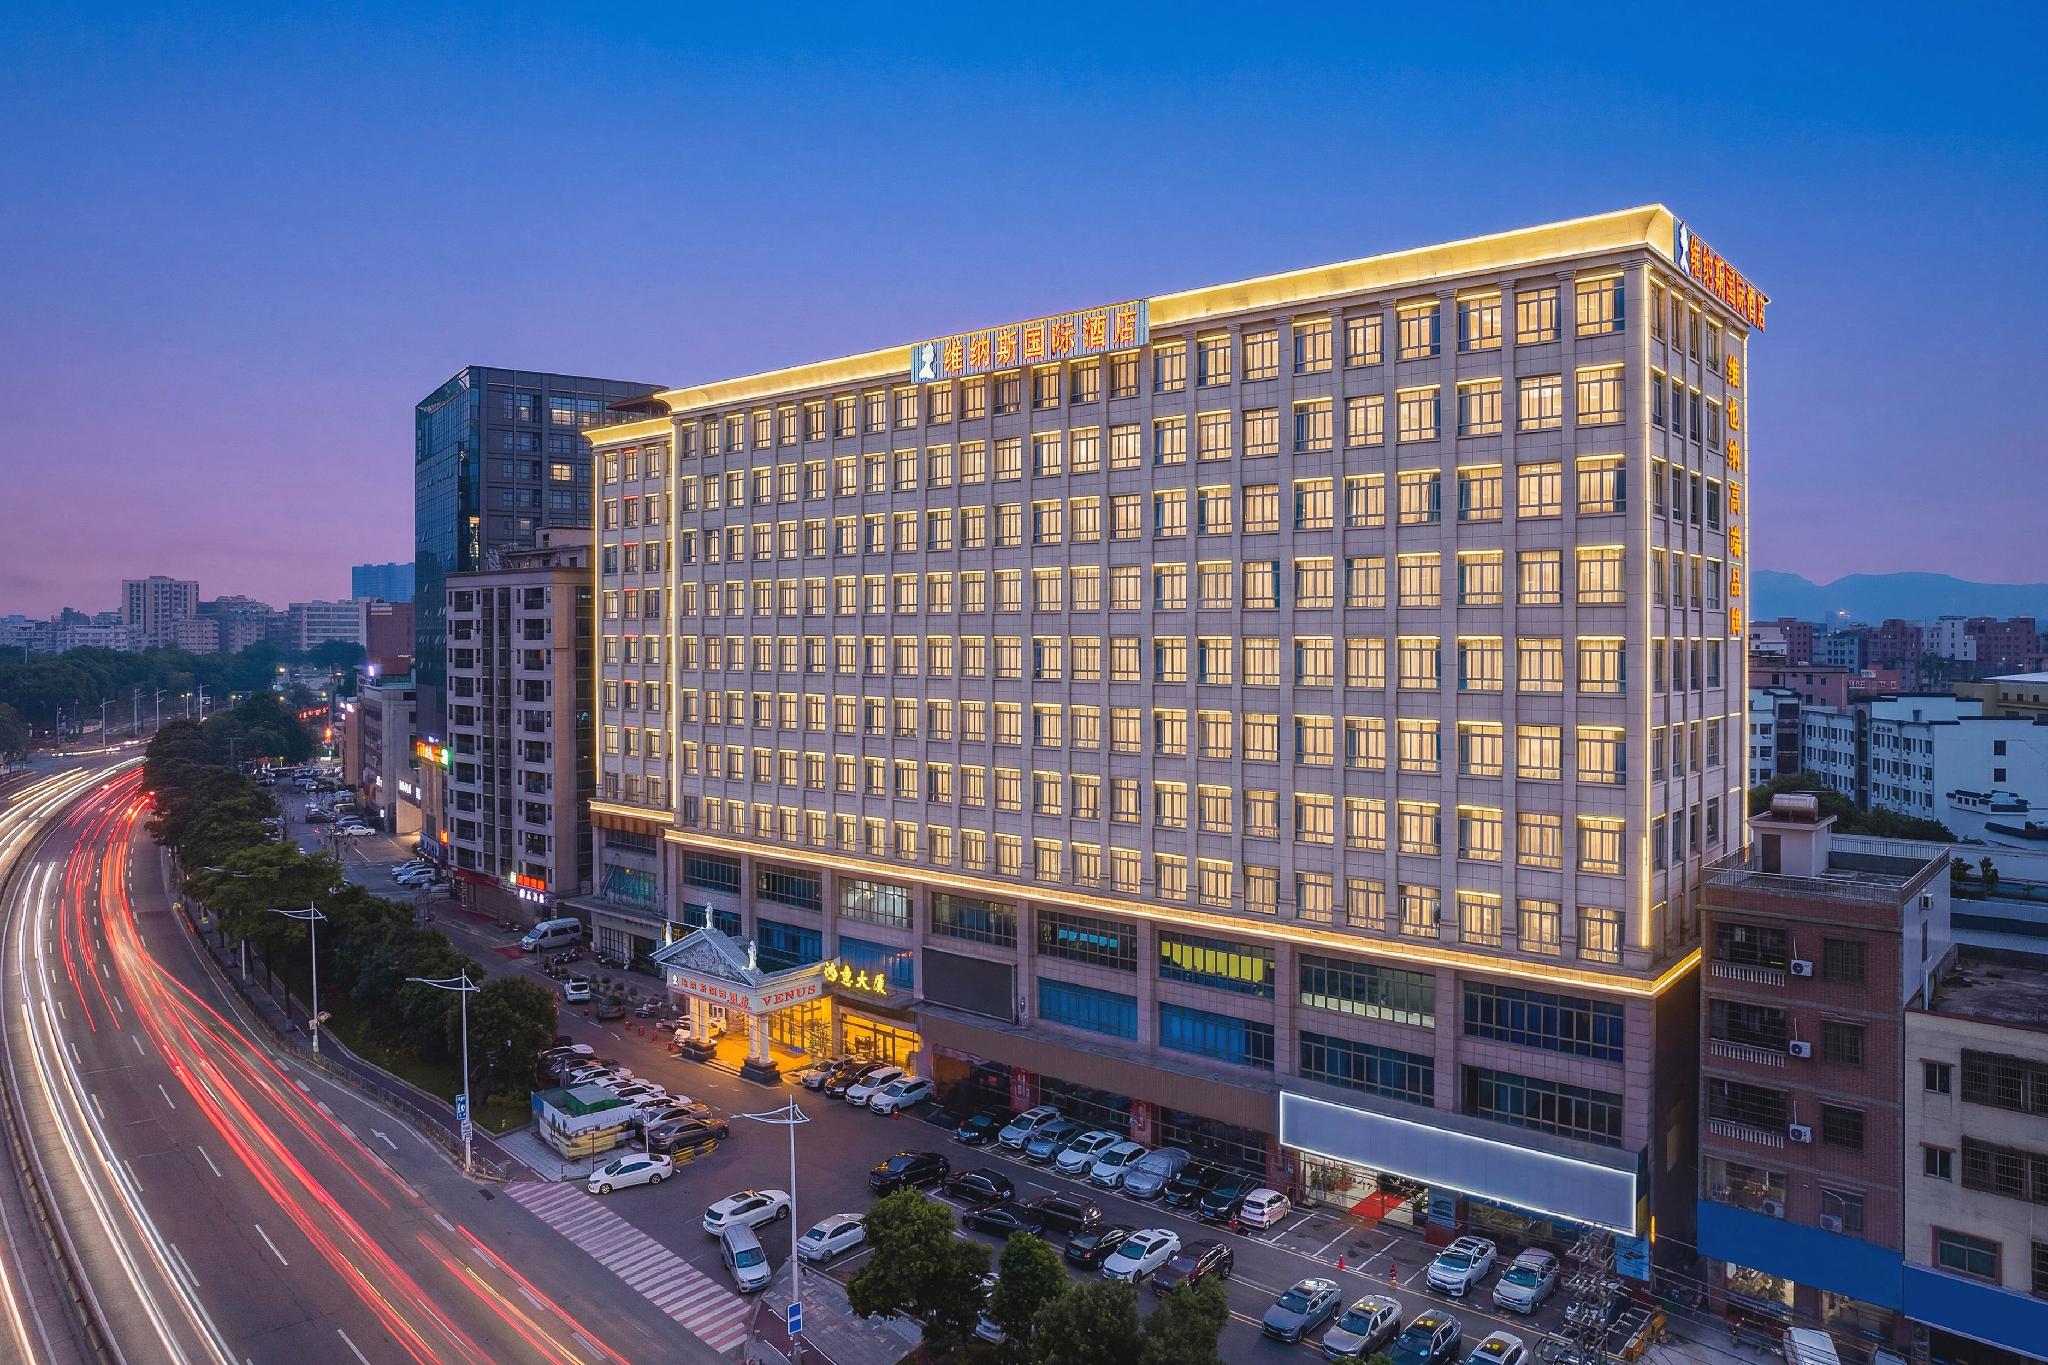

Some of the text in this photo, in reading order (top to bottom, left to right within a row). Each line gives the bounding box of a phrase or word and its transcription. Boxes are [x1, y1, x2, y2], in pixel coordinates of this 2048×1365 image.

[943, 307, 1138, 373] 维纳斯国际酒店
[762, 984, 817, 1008] VENUS
